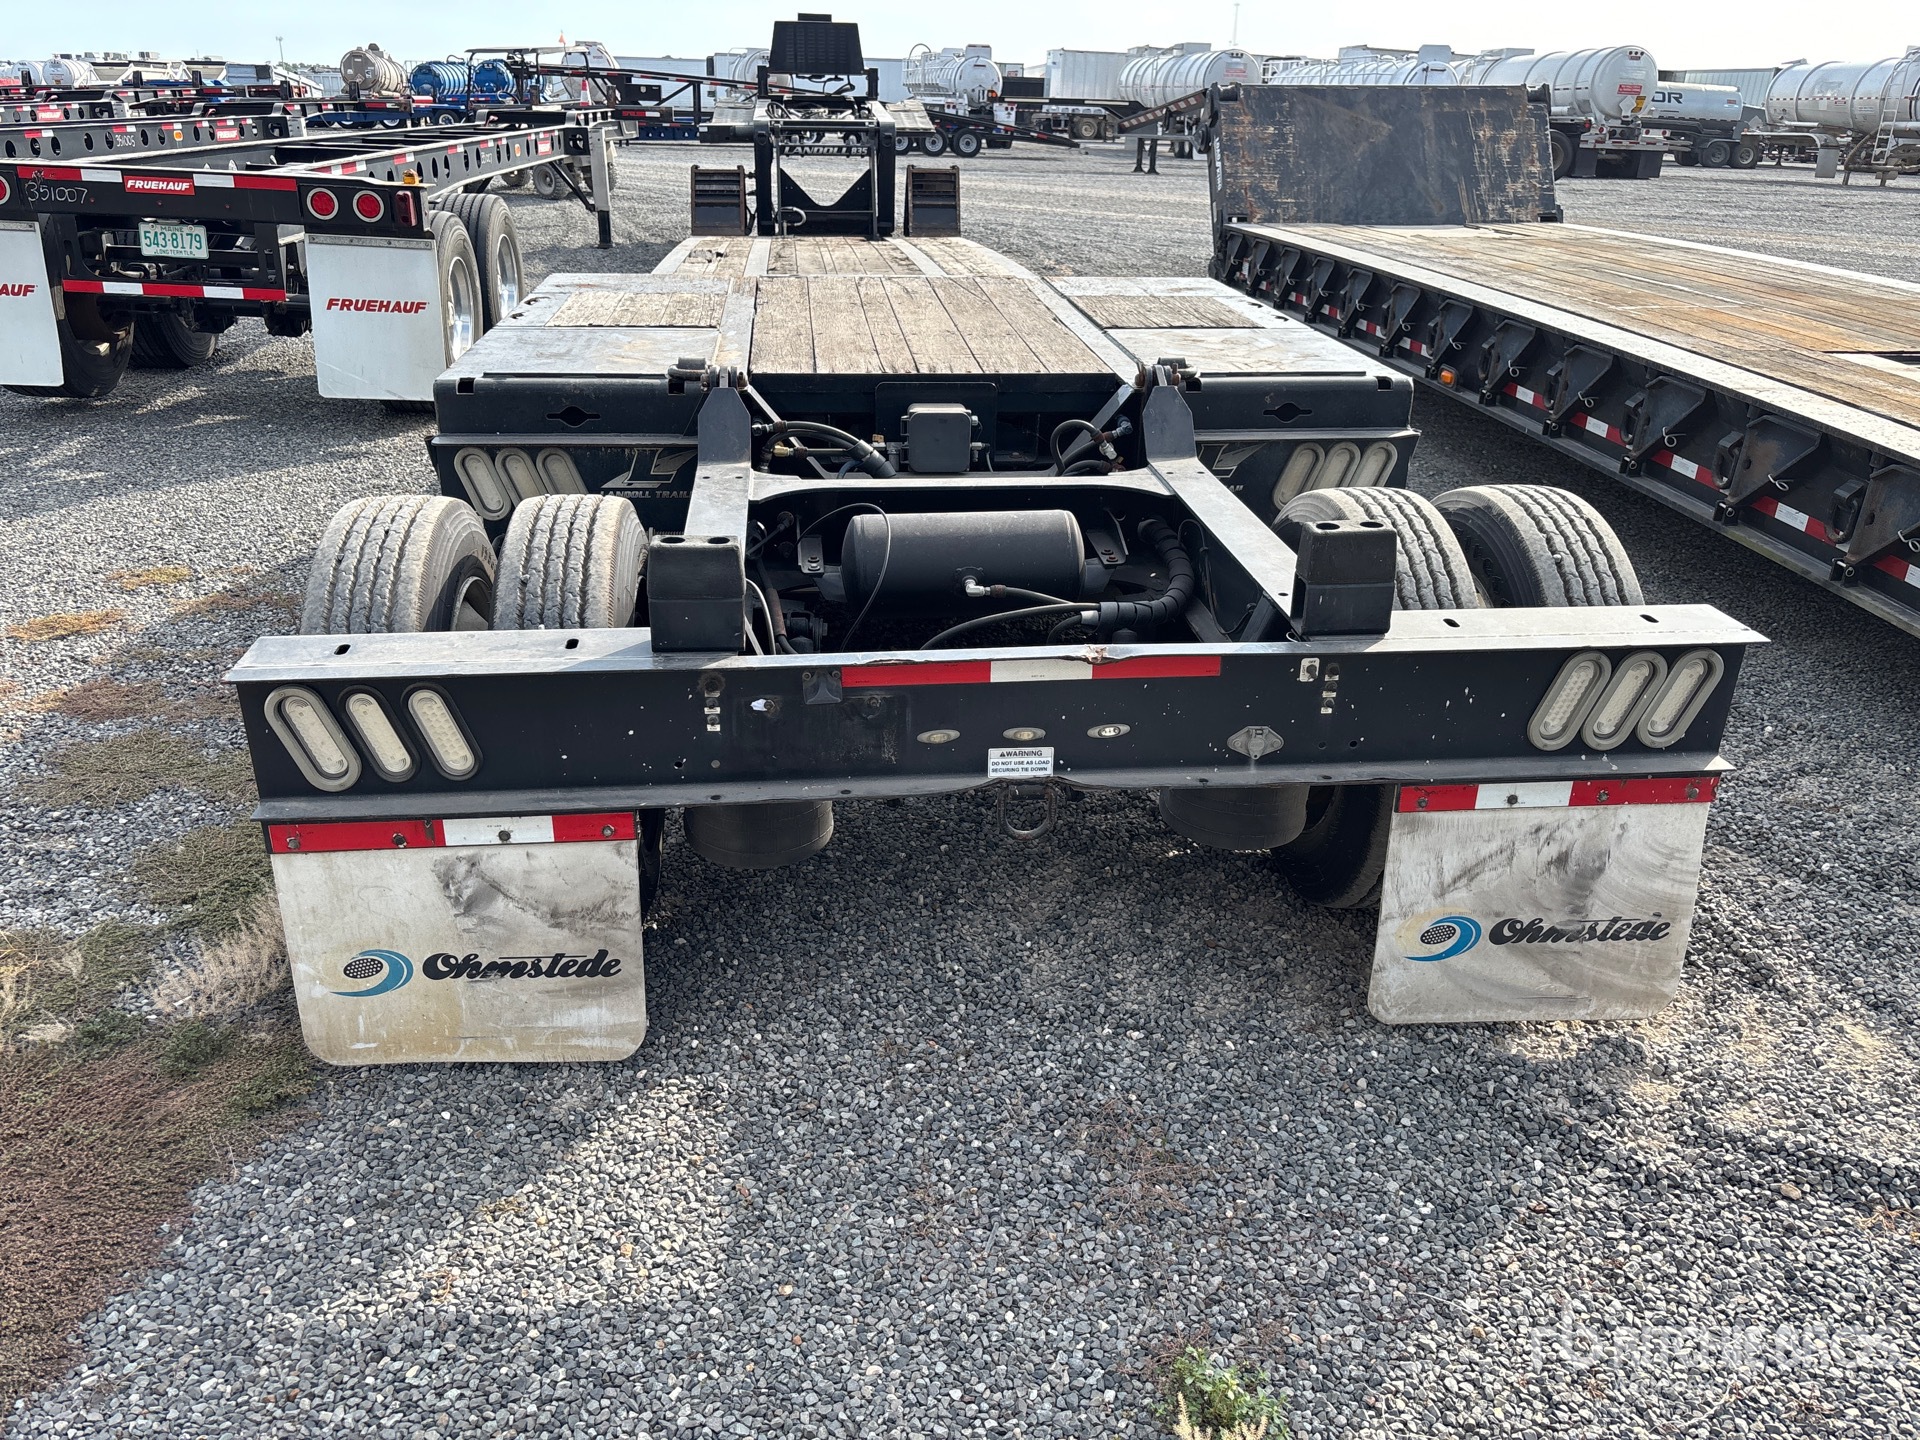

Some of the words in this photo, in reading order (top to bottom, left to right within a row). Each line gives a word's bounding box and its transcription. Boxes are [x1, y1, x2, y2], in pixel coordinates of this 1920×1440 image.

[784, 146, 850, 155] LANDOLL
[850, 147, 869, 155] 835
[126, 179, 190, 191] FRUEHAUF
[25, 181, 88, 204] 351007
[325, 297, 427, 314] FRUEHAUF
[1006, 749, 1043, 758] WARNING
[422, 949, 622, 981] Ohmstede
